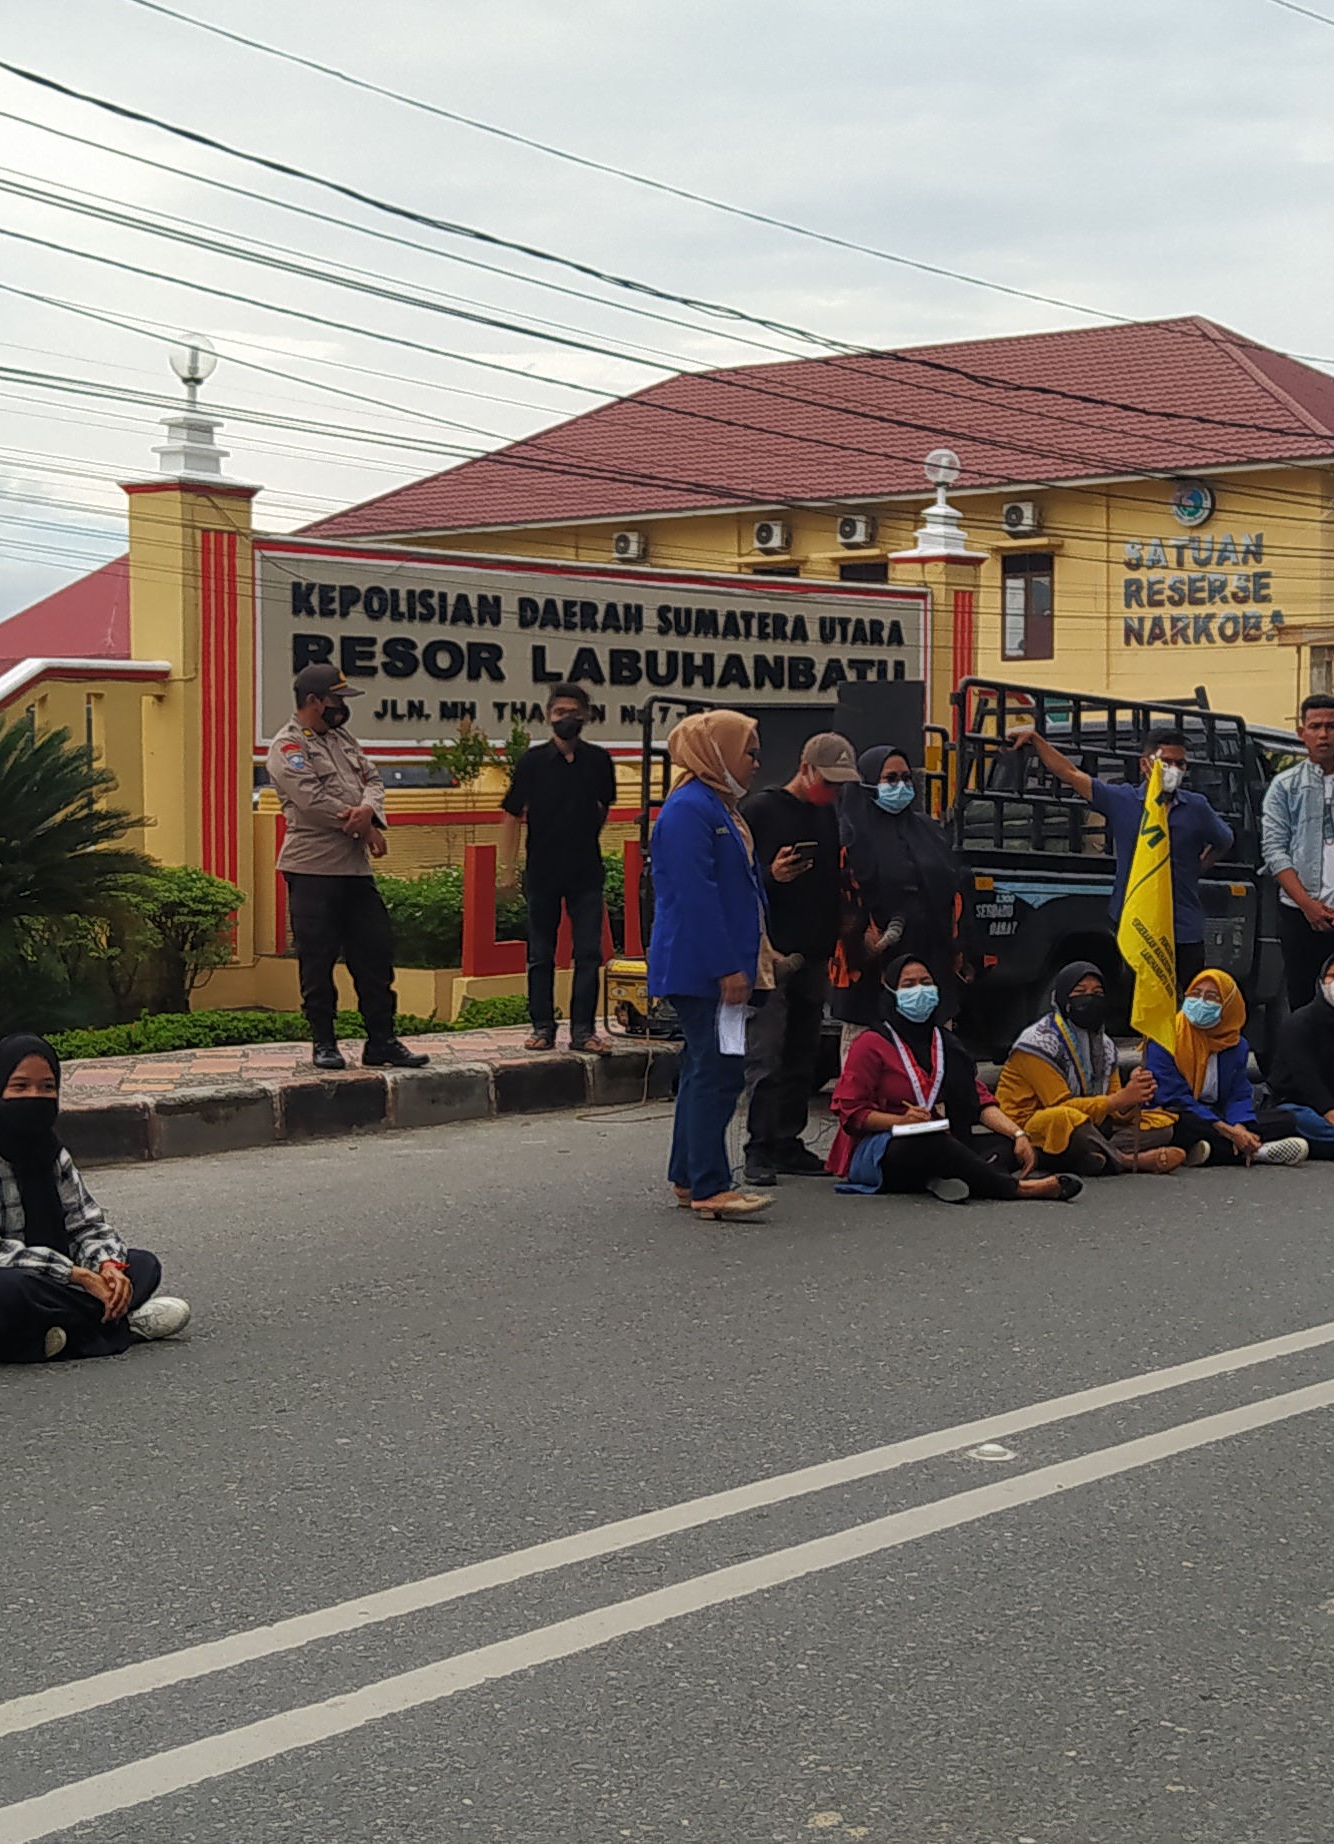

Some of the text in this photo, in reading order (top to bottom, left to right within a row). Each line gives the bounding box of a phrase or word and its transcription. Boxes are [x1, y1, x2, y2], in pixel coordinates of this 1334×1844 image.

[1123, 532, 1264, 572] SATUAN
[1123, 571, 1273, 610] RESERSE
[291, 581, 906, 647] KEPOLISIAN DAERAH SUMATERA UTARA
[292, 632, 505, 682] RESOR
[373, 699, 432, 721] JLN.
[439, 701, 477, 722] MH
